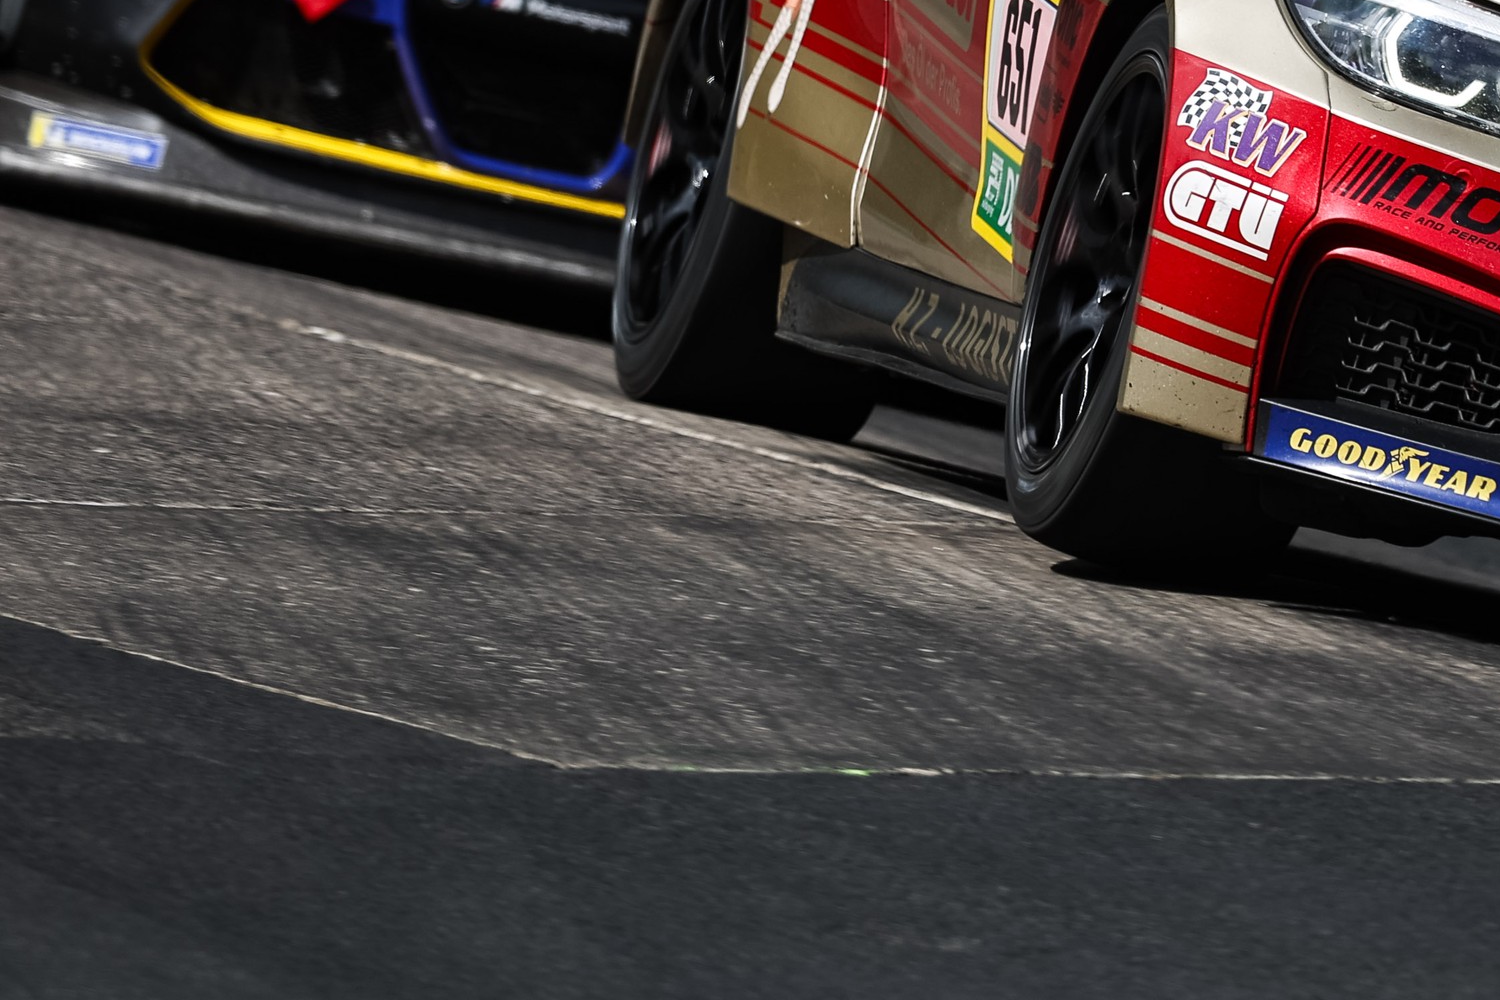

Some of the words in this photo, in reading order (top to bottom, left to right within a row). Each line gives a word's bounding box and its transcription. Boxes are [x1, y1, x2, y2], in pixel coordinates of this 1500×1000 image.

[1186, 98, 1308, 178] KW
[1374, 201, 1412, 221] RACE
[1415, 216, 1445, 233] AND
